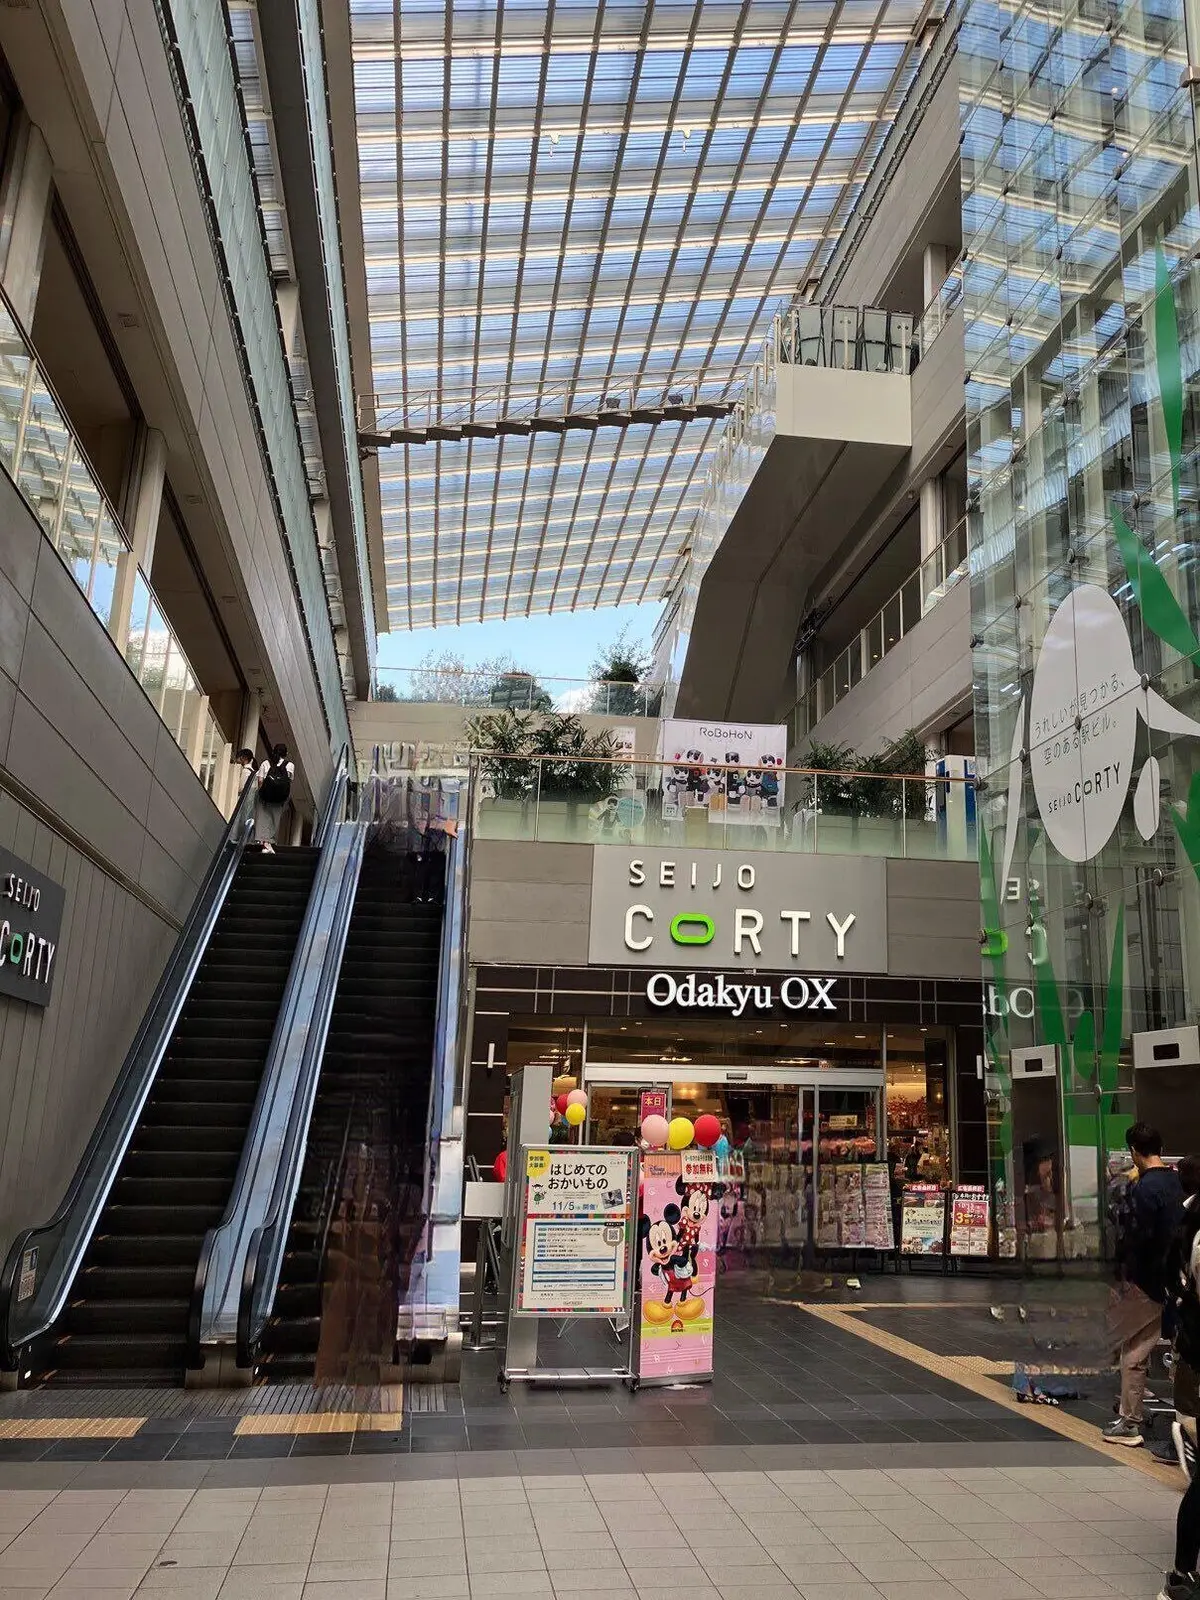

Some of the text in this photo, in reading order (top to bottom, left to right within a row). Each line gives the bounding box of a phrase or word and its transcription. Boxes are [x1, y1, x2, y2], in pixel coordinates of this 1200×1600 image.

[1048, 762, 1121, 813] SEIJO CORTY
[7, 873, 41, 912] SEIJO
[629, 858, 757, 891] SEIJO
[624, 903, 857, 958] CORTY
[0, 919, 56, 984] CORTY
[646, 972, 838, 1017] Odakyu OX
[644, 1096, 662, 1106] 本日
[548, 1177, 609, 1190] おかいもの
[550, 1163, 608, 1176] はじめての
[685, 1163, 714, 1175] 参加無料
